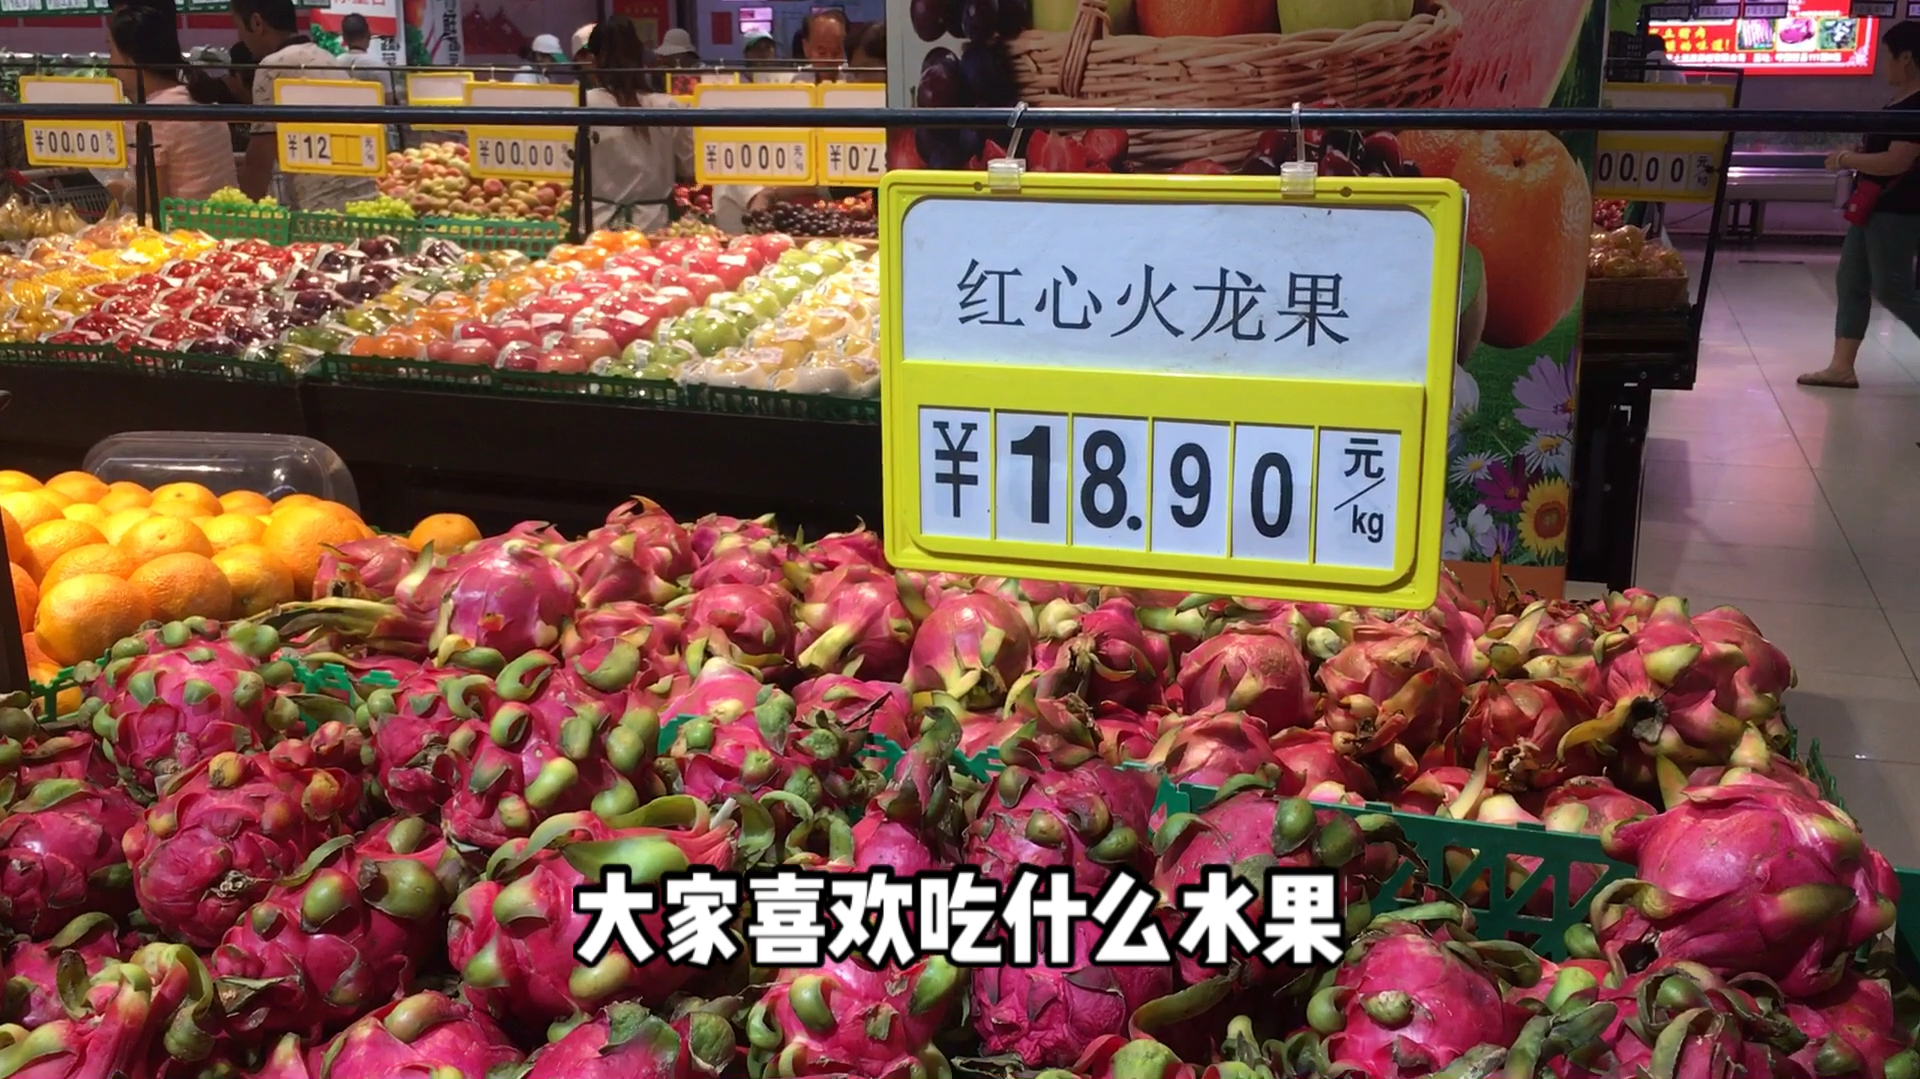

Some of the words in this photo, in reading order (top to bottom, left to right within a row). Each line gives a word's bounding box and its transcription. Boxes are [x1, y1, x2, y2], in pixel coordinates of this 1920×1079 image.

[957, 258, 1350, 348] 红心火龙果
